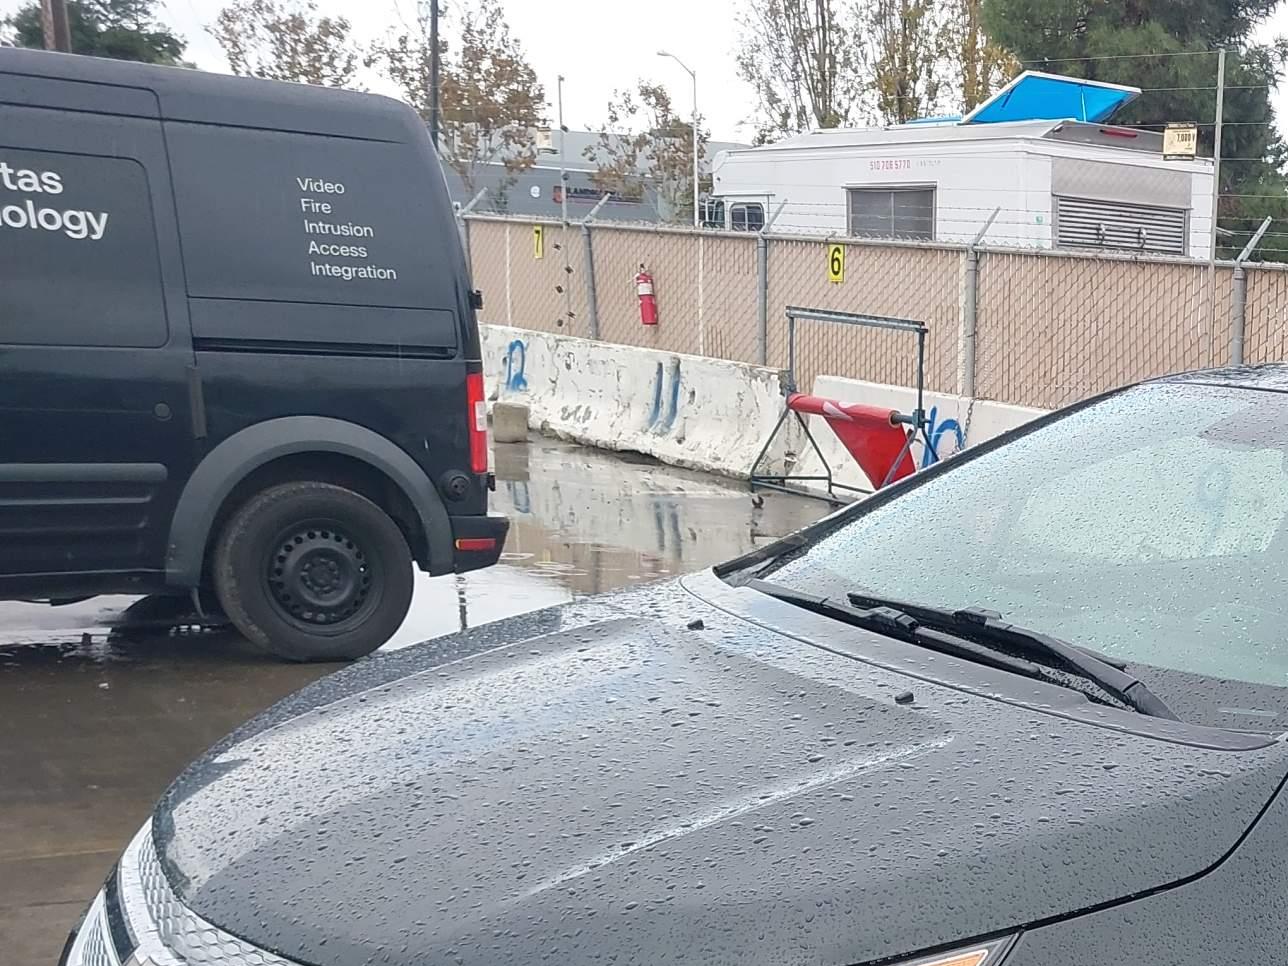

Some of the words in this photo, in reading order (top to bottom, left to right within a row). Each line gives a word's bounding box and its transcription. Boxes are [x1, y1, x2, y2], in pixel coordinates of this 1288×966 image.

[297, 177, 345, 194] Video
[301, 198, 332, 214] Fire
[0, 200, 108, 240] ology
[304, 219, 374, 237] Intrusion
[308, 241, 368, 257] Access
[831, 246, 841, 276] 6
[311, 261, 397, 280] Integration
